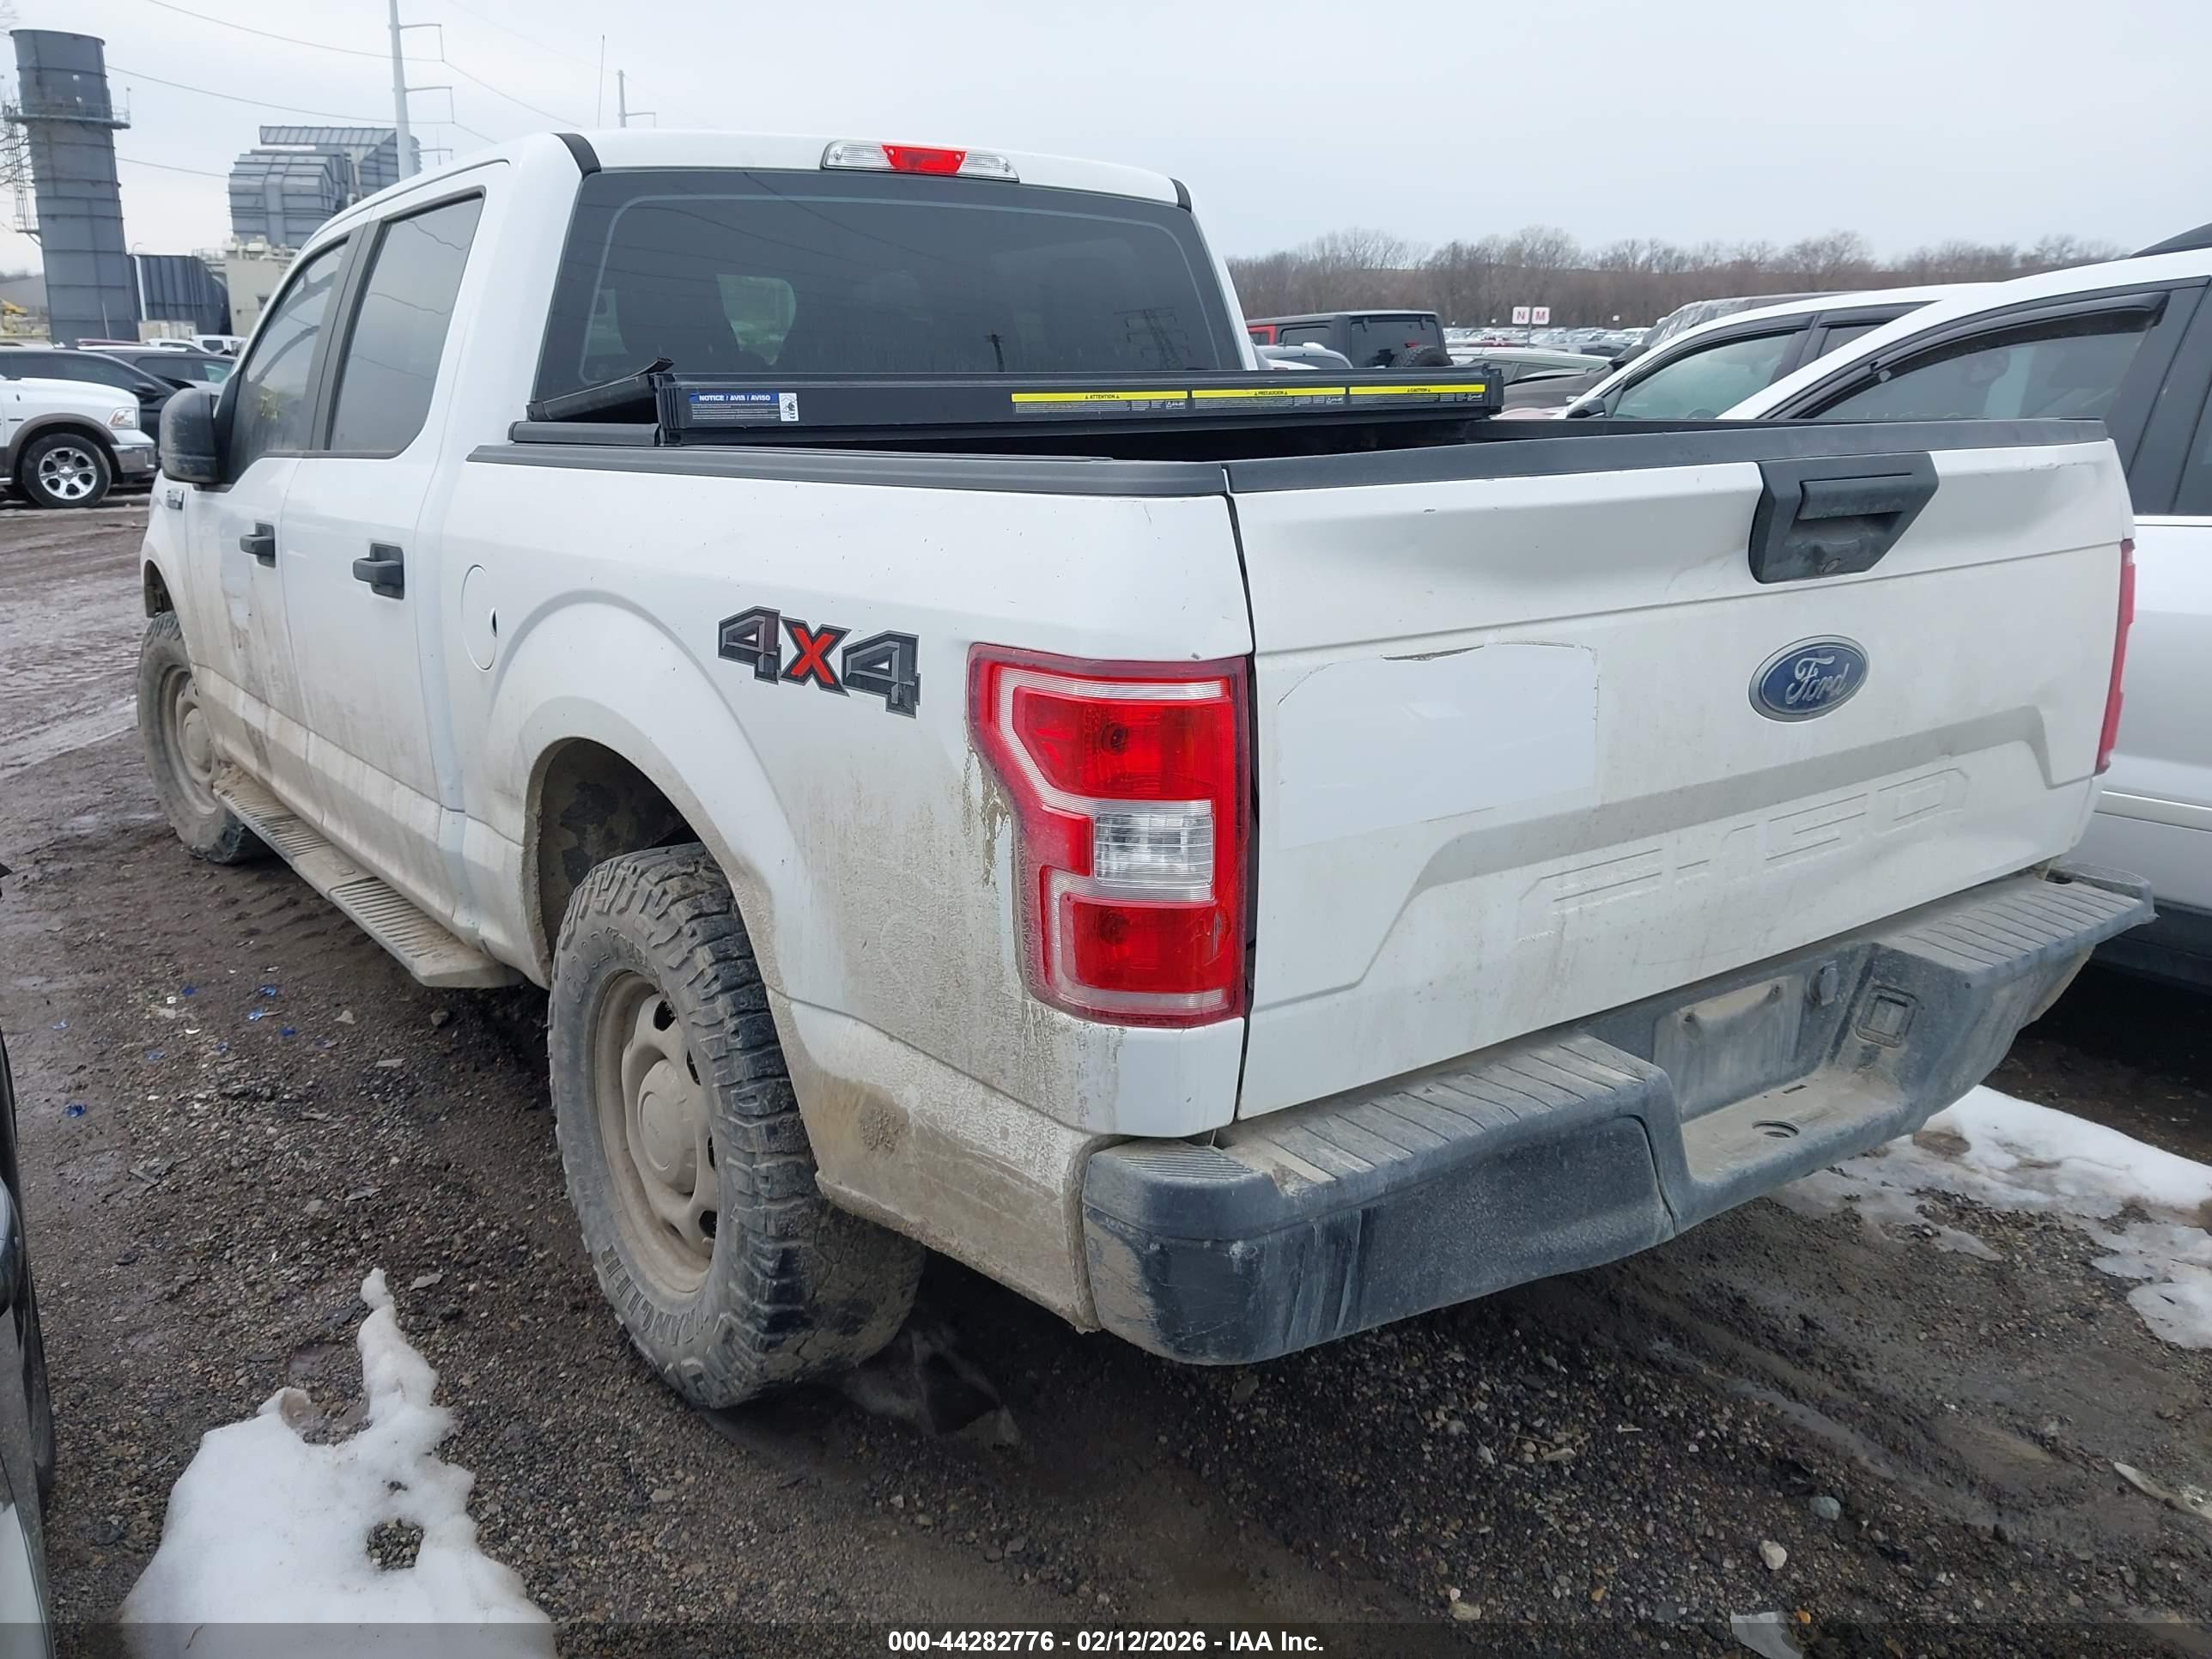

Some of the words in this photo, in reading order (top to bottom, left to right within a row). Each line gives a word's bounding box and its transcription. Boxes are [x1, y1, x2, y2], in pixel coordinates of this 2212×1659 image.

[1516, 311, 1525, 320] N
[1534, 311, 1546, 321] M
[1784, 655, 1850, 705] Ford
[1516, 767, 1971, 943] F-150
